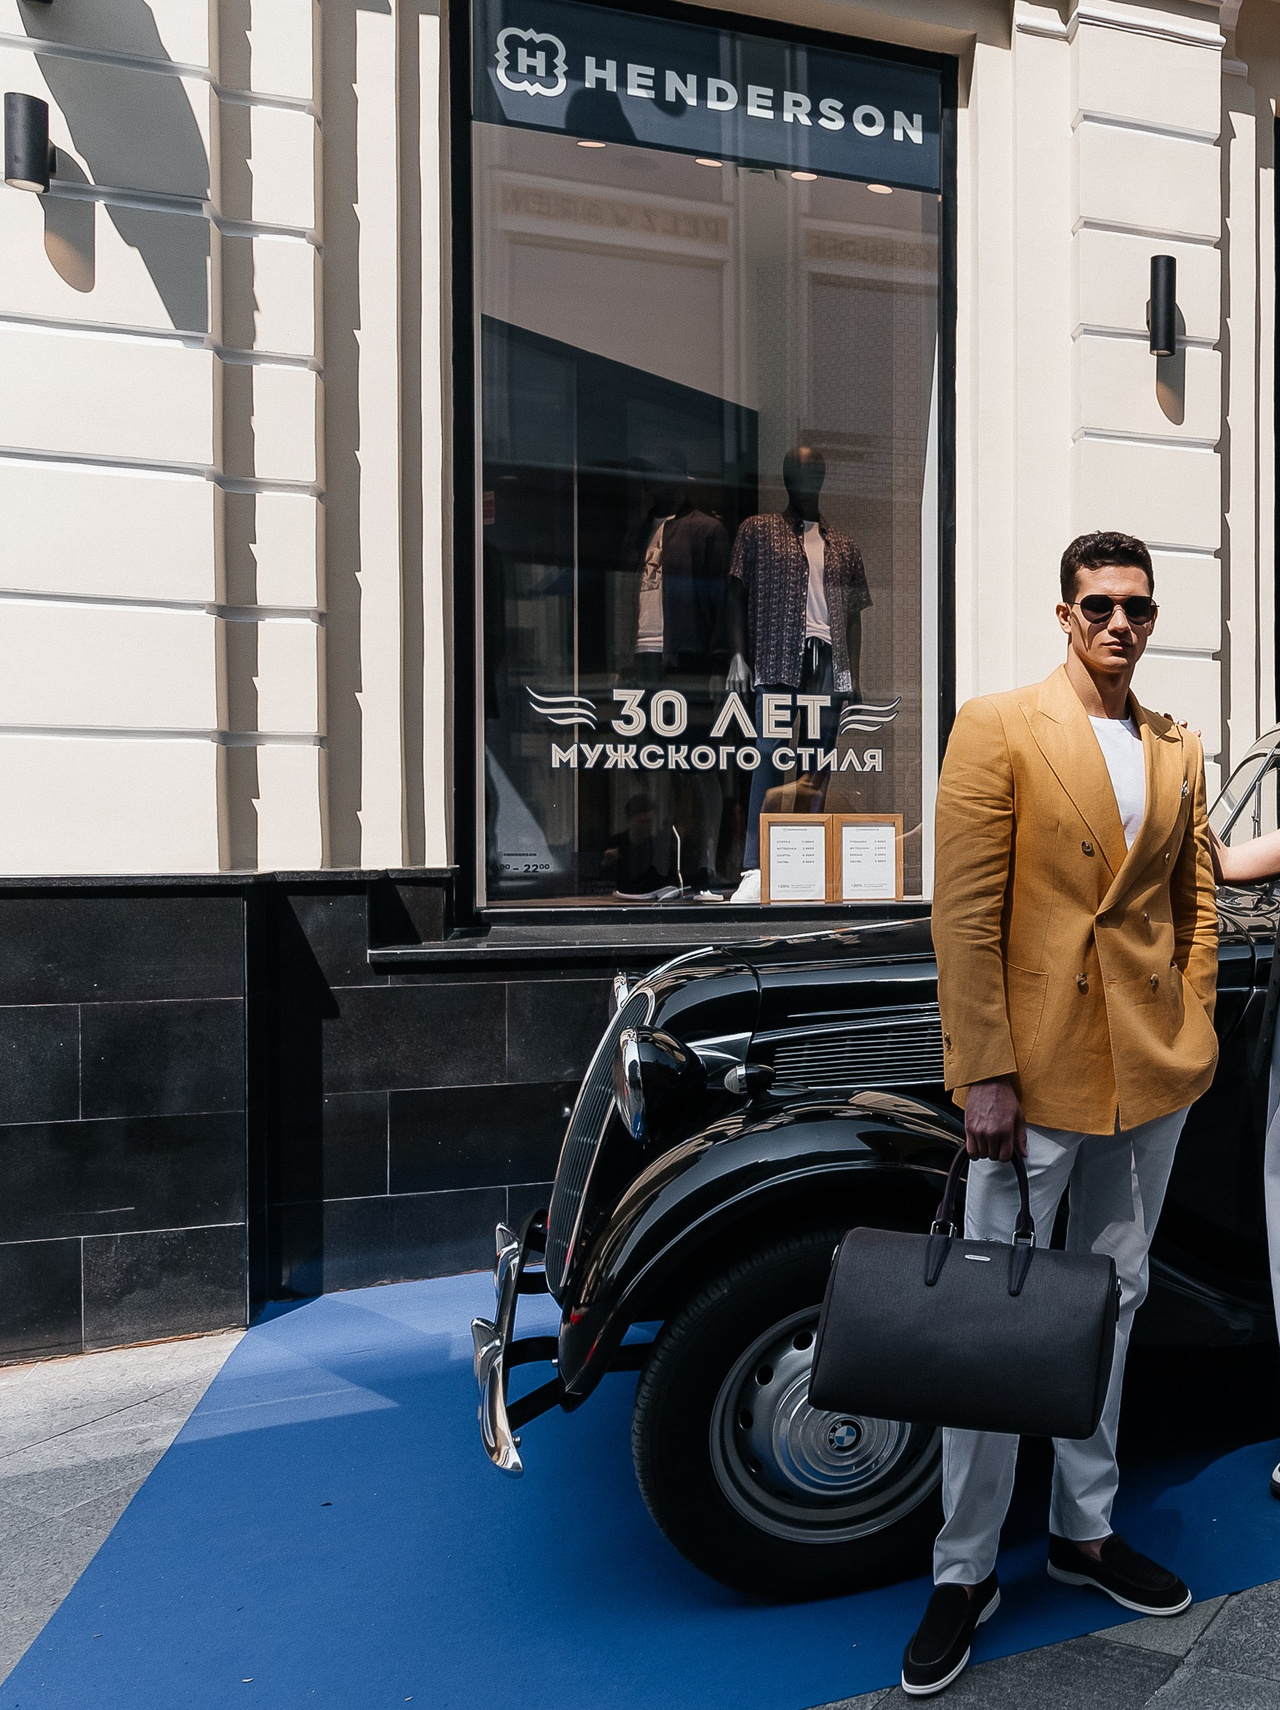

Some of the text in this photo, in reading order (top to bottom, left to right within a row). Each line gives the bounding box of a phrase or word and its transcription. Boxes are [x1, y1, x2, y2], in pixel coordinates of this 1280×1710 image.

[584, 55, 925, 145] HENDERSON
[610, 688, 832, 740] 30 ЛЕТ
[550, 743, 884, 773] МУЖСКОГО СТИЛЯ
